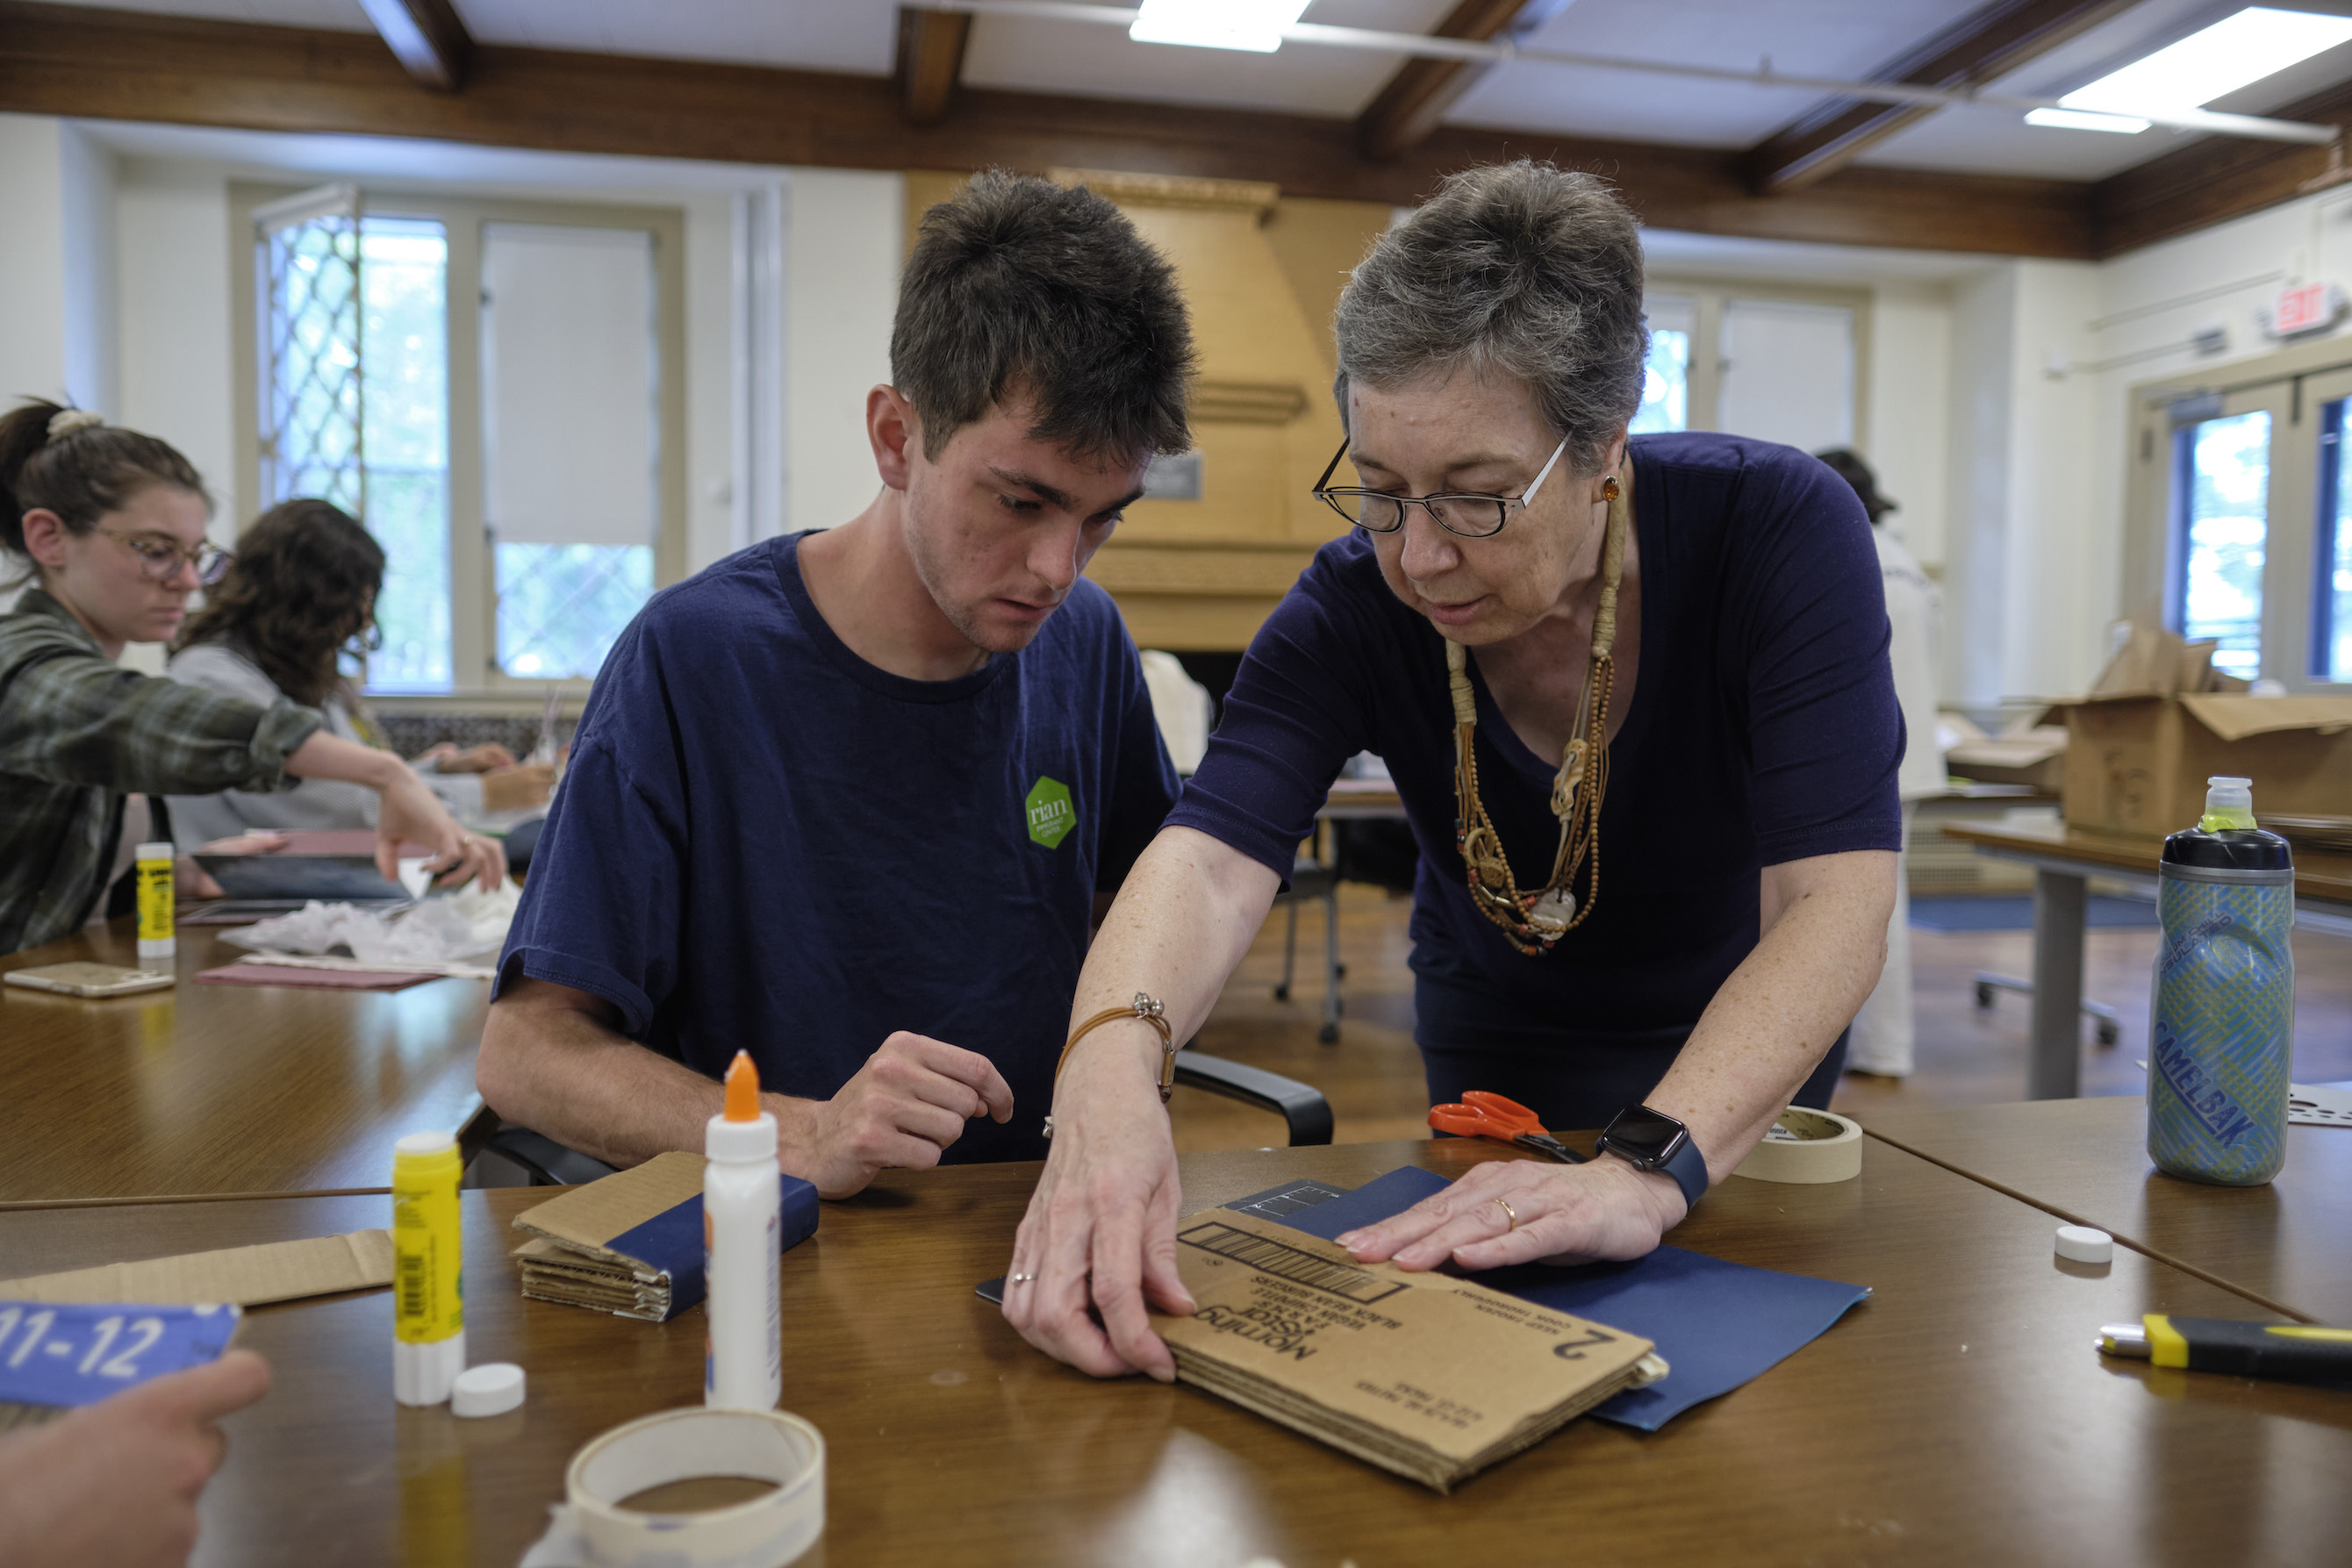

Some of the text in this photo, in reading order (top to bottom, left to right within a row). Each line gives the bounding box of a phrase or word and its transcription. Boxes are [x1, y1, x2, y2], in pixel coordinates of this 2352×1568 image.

[1030, 799, 1068, 825] rian
[2160, 915, 2233, 974] NSULATED
[1251, 1275, 1403, 1330] BLACK BEAN BURGERS
[1251, 1287, 1367, 1331] VEGAN CHIPOTLE
[1451, 1288, 1572, 1331] COOK THOROUGHLY
[1474, 1304, 1560, 1336] KEEP FROZEN
[1193, 1305, 1317, 1361] Morning
[1552, 1328, 1618, 1361] 2
